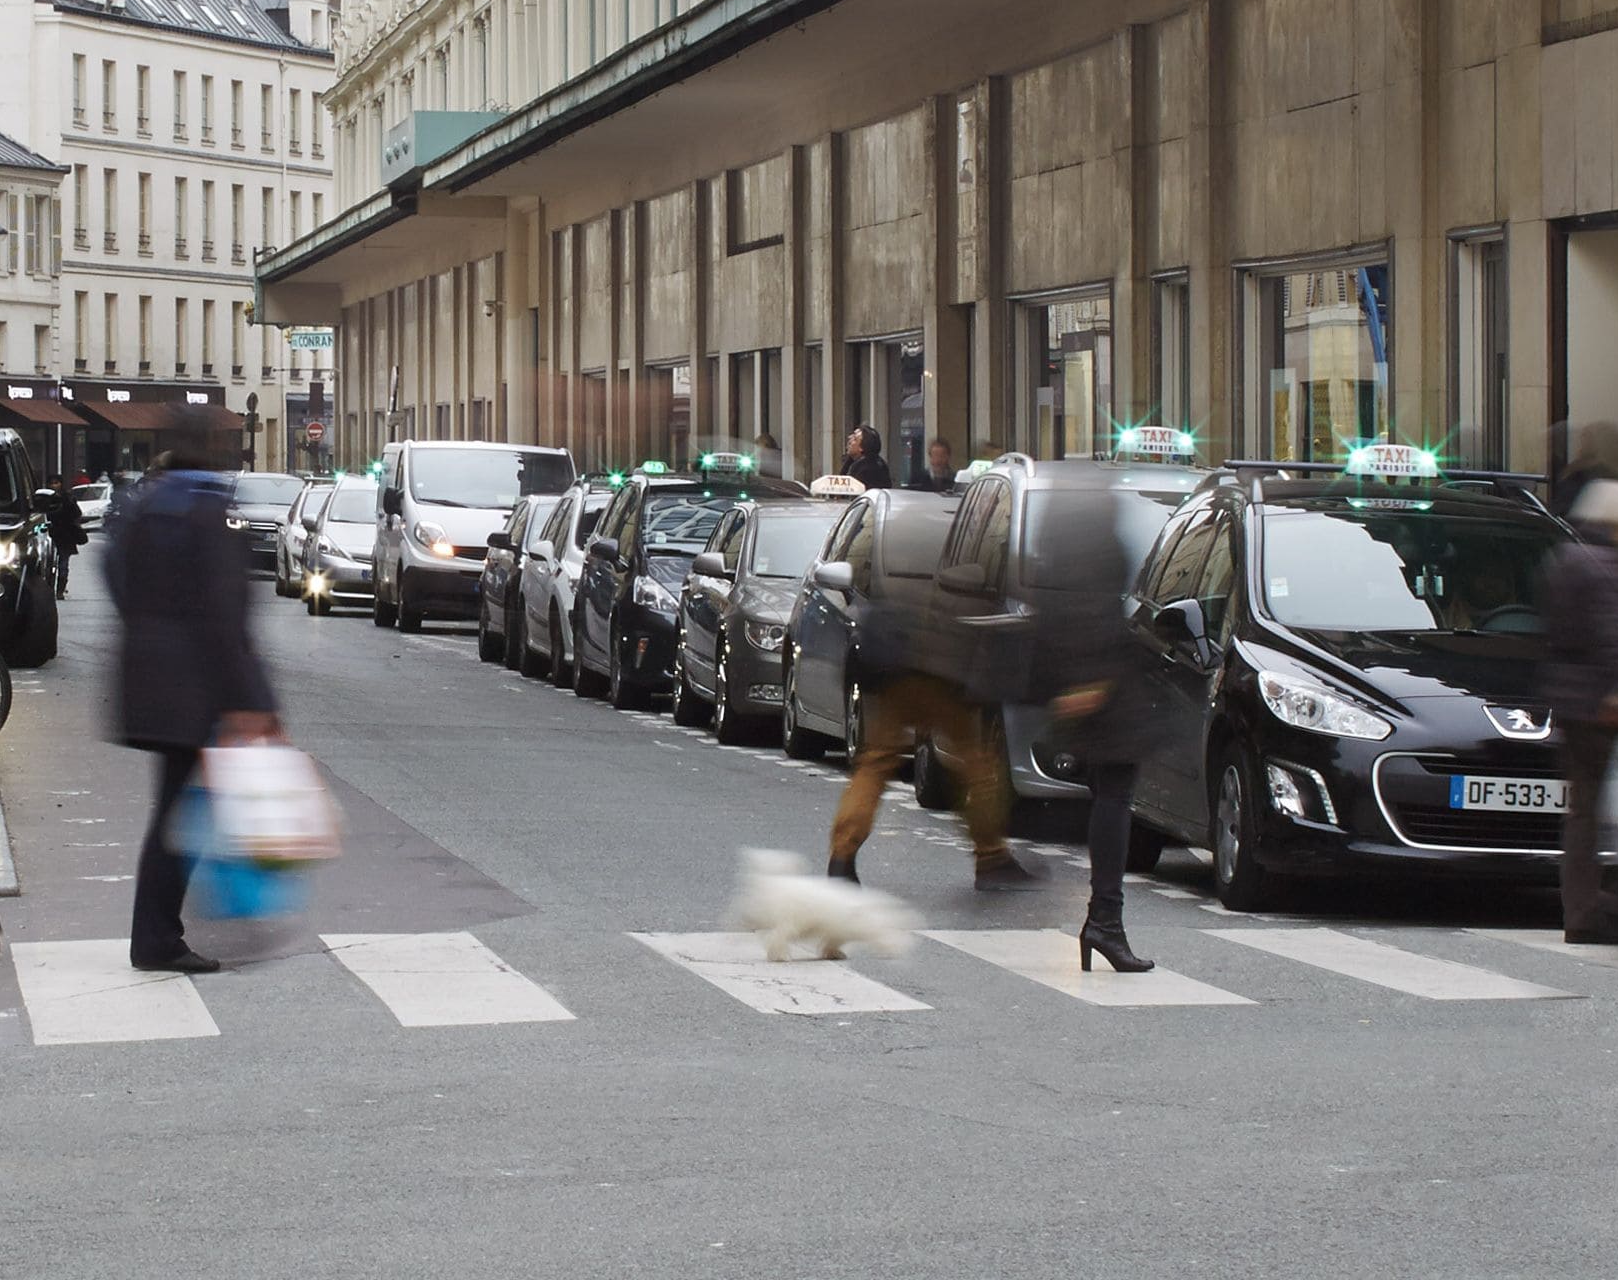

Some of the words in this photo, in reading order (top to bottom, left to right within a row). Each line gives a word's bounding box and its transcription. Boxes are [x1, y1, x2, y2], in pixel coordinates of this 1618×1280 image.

[1141, 429, 1172, 443] TAXI
[1374, 448, 1410, 463] TAXI
[1368, 464, 1418, 472] PARISIEN
[827, 476, 851, 486] TAXI
[1468, 781, 1568, 809] DF-533-J
